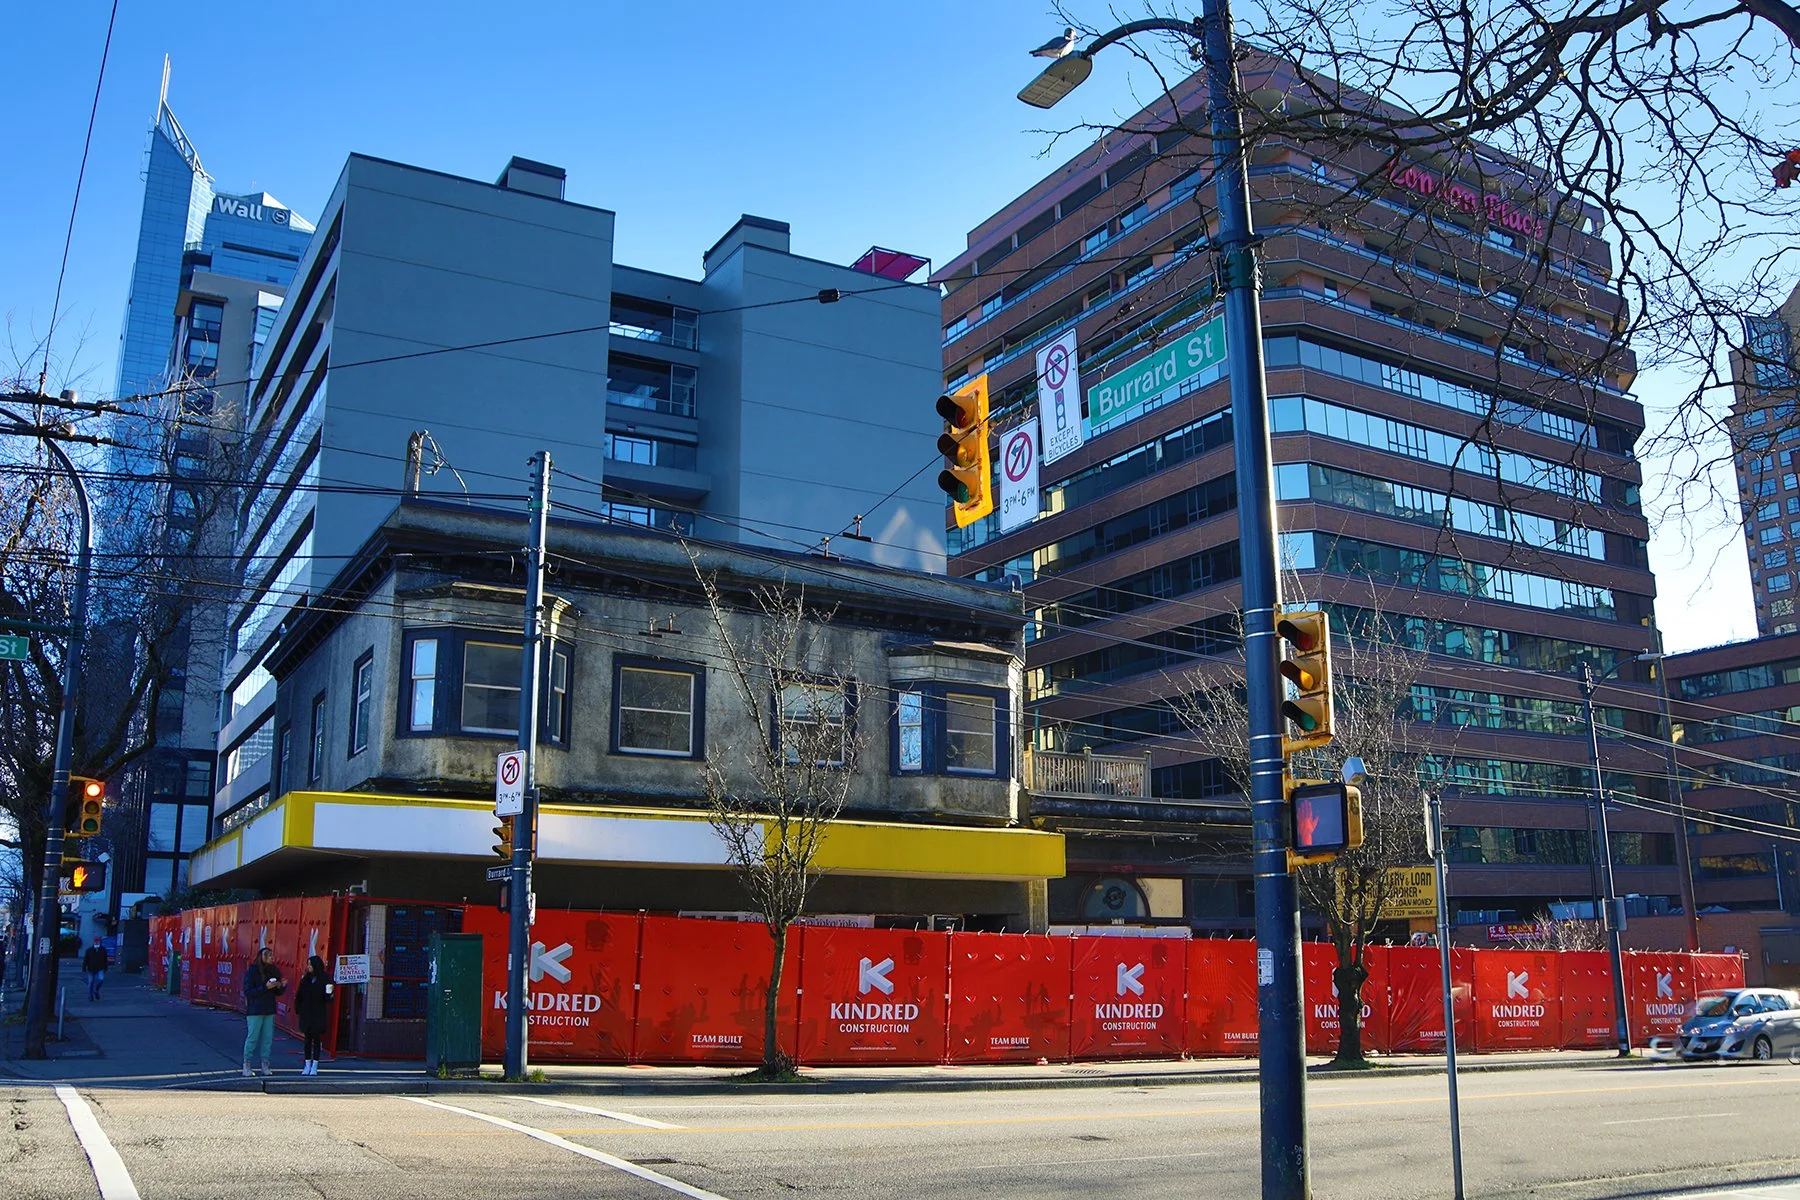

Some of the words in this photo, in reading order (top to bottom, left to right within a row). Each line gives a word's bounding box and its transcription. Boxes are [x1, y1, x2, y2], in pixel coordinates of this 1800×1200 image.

[218, 197, 262, 221] Wall
[1099, 350, 1177, 416] Burrard
[1188, 332, 1213, 367] St
[1050, 426, 1074, 447] EXCEPT
[1048, 435, 1079, 459] BICYCLES
[0, 639, 17, 655] St
[1410, 872, 1432, 886] LOAN
[494, 991, 601, 1012] KNDRED
[830, 1003, 919, 1020] KINDRED
[1095, 1003, 1164, 1019] KINDRED
[1315, 1004, 1371, 1018] KIND
[1492, 1005, 1544, 1018] KINDRED
[1646, 1003, 1685, 1015] KINDRED
[840, 1023, 909, 1033] CONSTRUCTION
[1102, 1022, 1157, 1031] CONSTRUCTION
[692, 1034, 717, 1043] TEAM
[718, 1034, 743, 1043] BUILT
[990, 1037, 1010, 1045] TEAM
[1010, 1037, 1030, 1045] BUILT
[1224, 1032, 1241, 1040] TEAM
[1241, 1032, 1259, 1040] BUILT
[1420, 1030, 1433, 1038] TEAM
